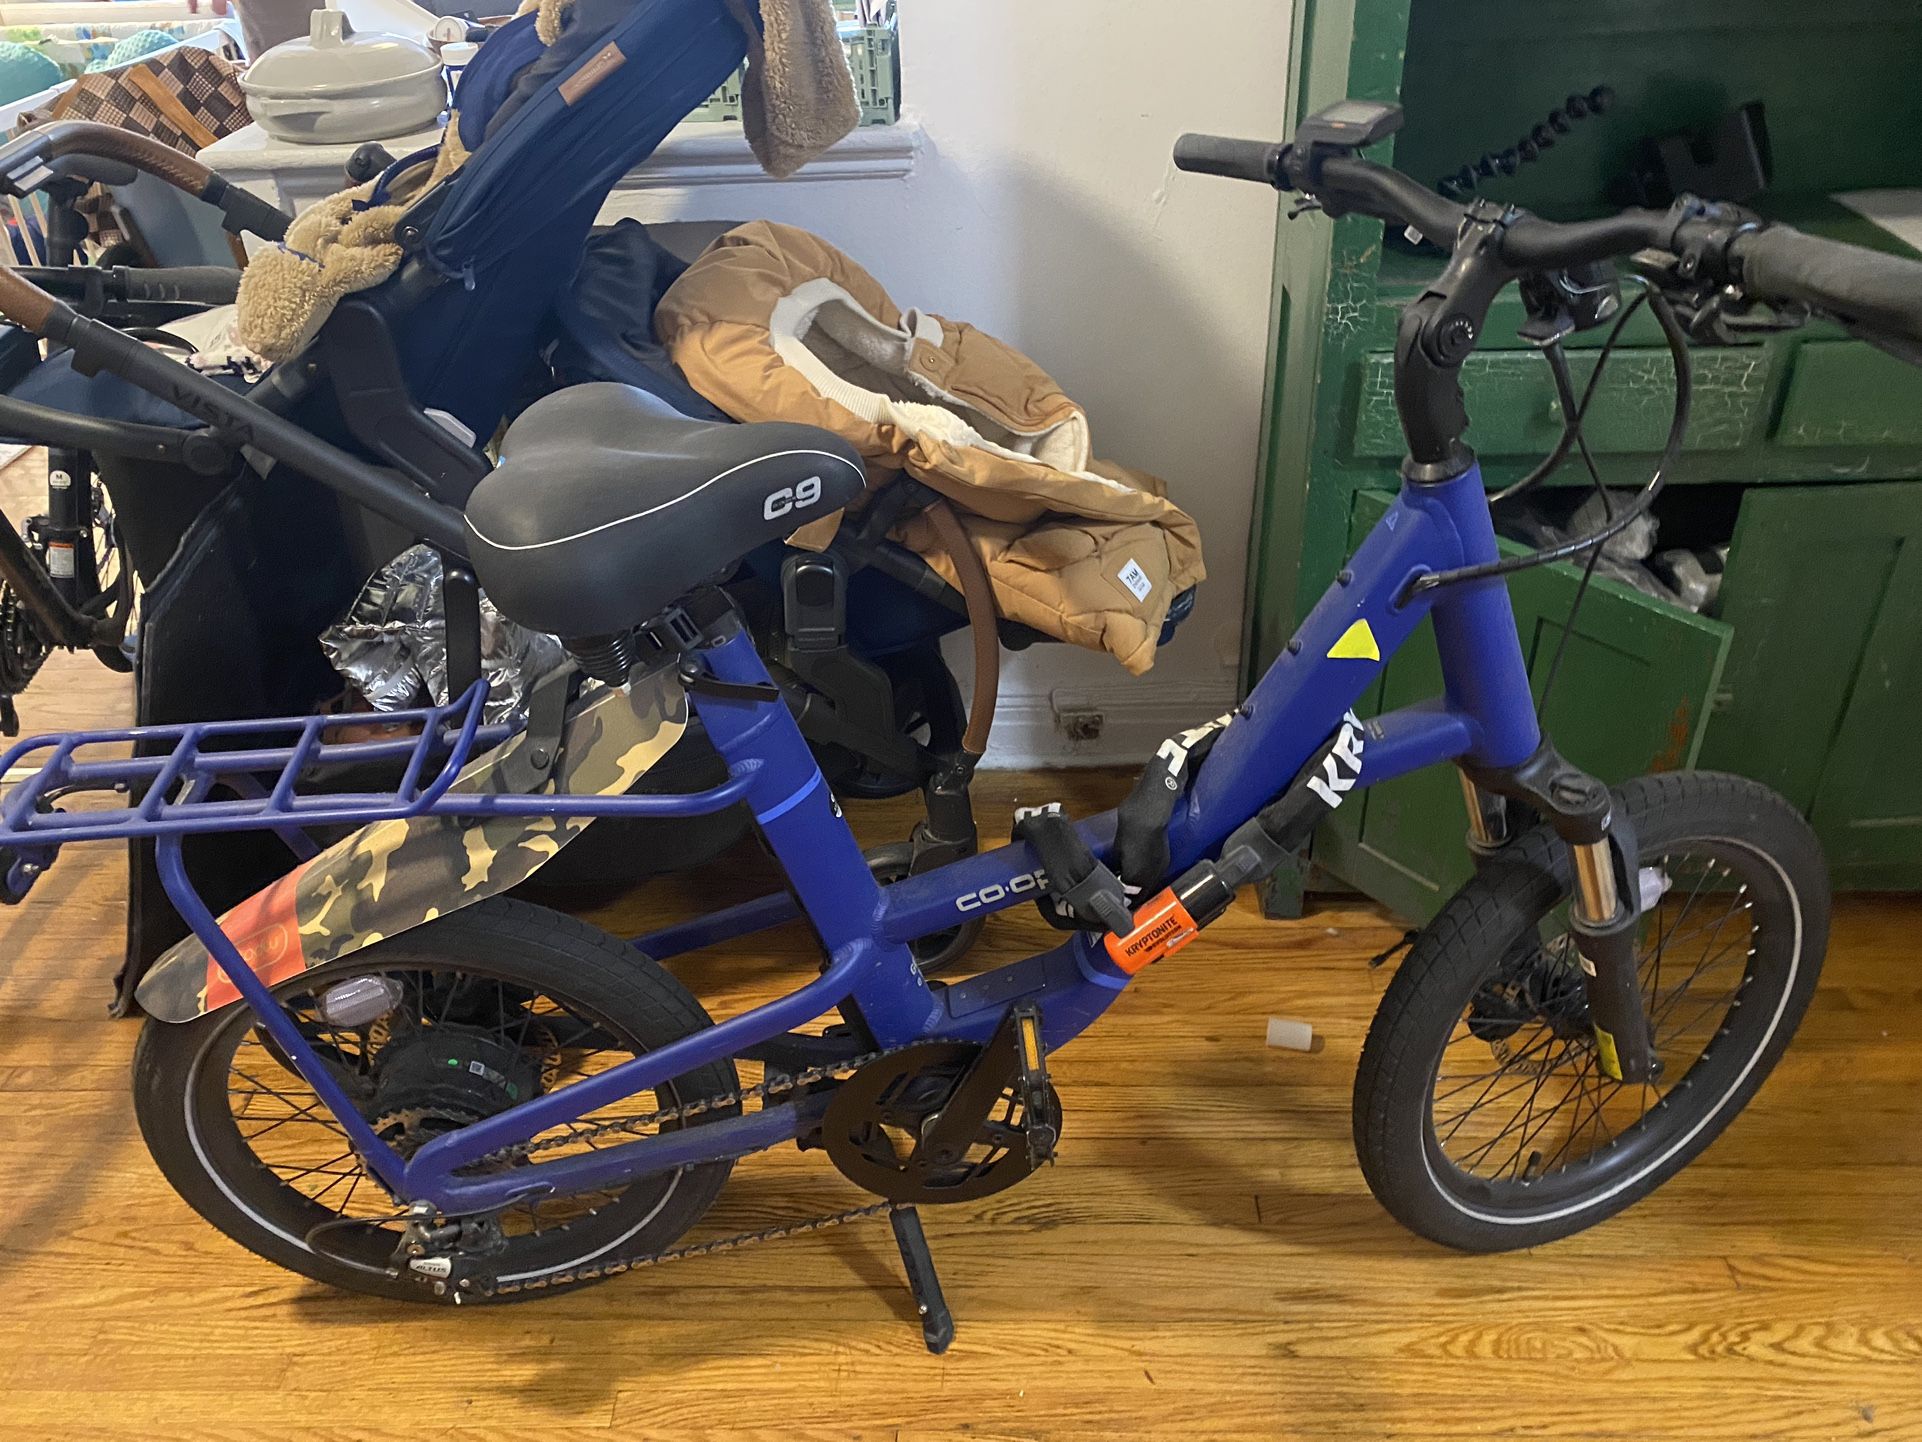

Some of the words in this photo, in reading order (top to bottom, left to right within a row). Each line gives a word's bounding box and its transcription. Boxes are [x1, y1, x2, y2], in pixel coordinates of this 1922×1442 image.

[172, 382, 254, 442] VISTA
[763, 475, 821, 521] C9
[1124, 915, 1178, 957] KRYPTONITE
